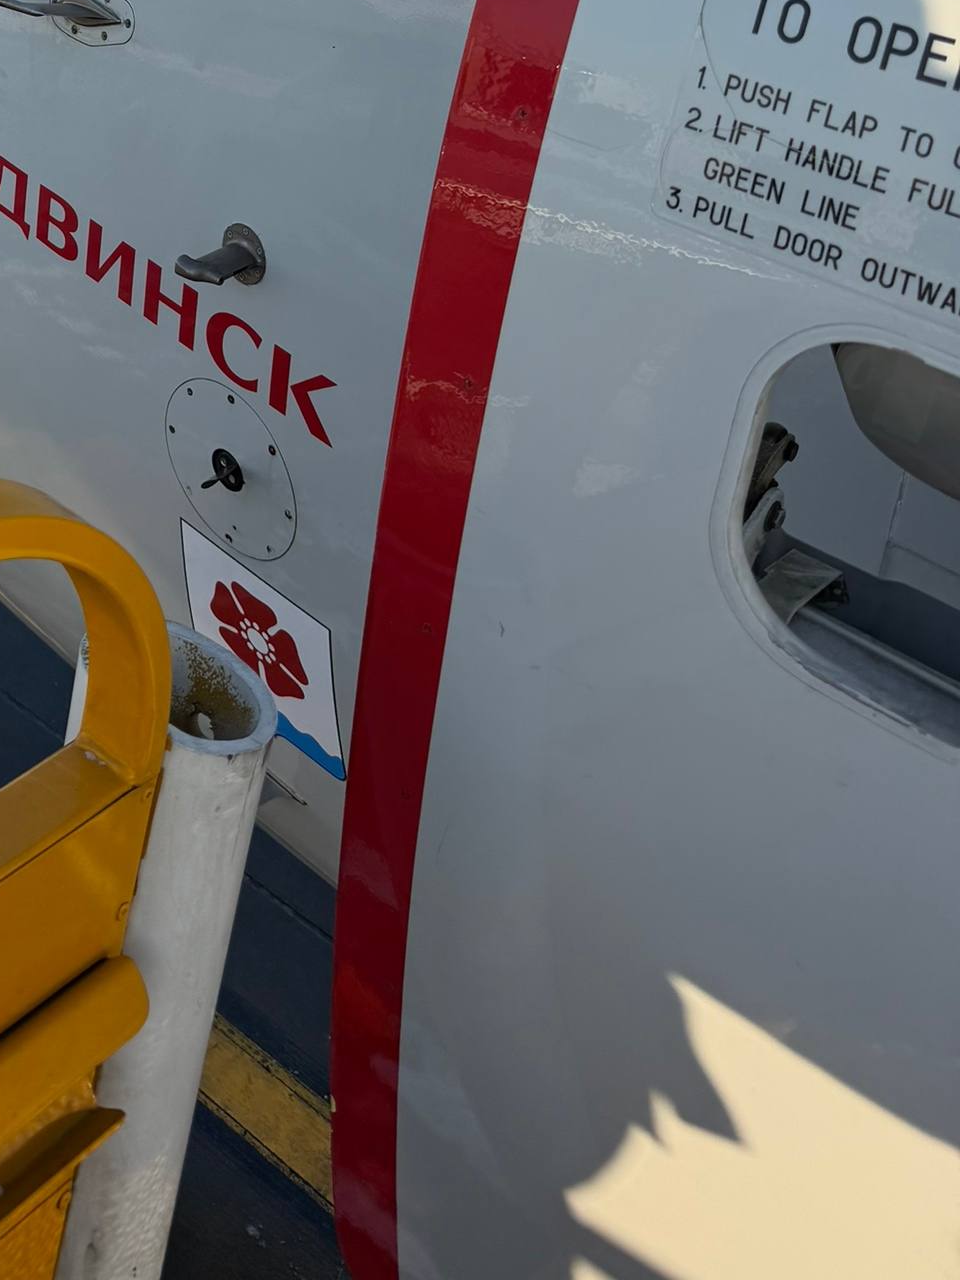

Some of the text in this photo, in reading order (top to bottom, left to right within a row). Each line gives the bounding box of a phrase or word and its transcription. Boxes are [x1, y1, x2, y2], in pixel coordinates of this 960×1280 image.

[847, 16, 960, 91] OPE
[698, 66, 706, 90] 1.
[724, 74, 792, 115] PUSH
[807, 99, 878, 138] FLAP
[901, 126, 934, 158] TO
[704, 157, 860, 231] GREEN LINE
[713, 115, 770, 152] LIFT
[785, 138, 890, 194] HANDLE
[693, 196, 754, 239] PULL
[773, 225, 842, 270] DOOR
[861, 258, 960, 316] OUTWA
